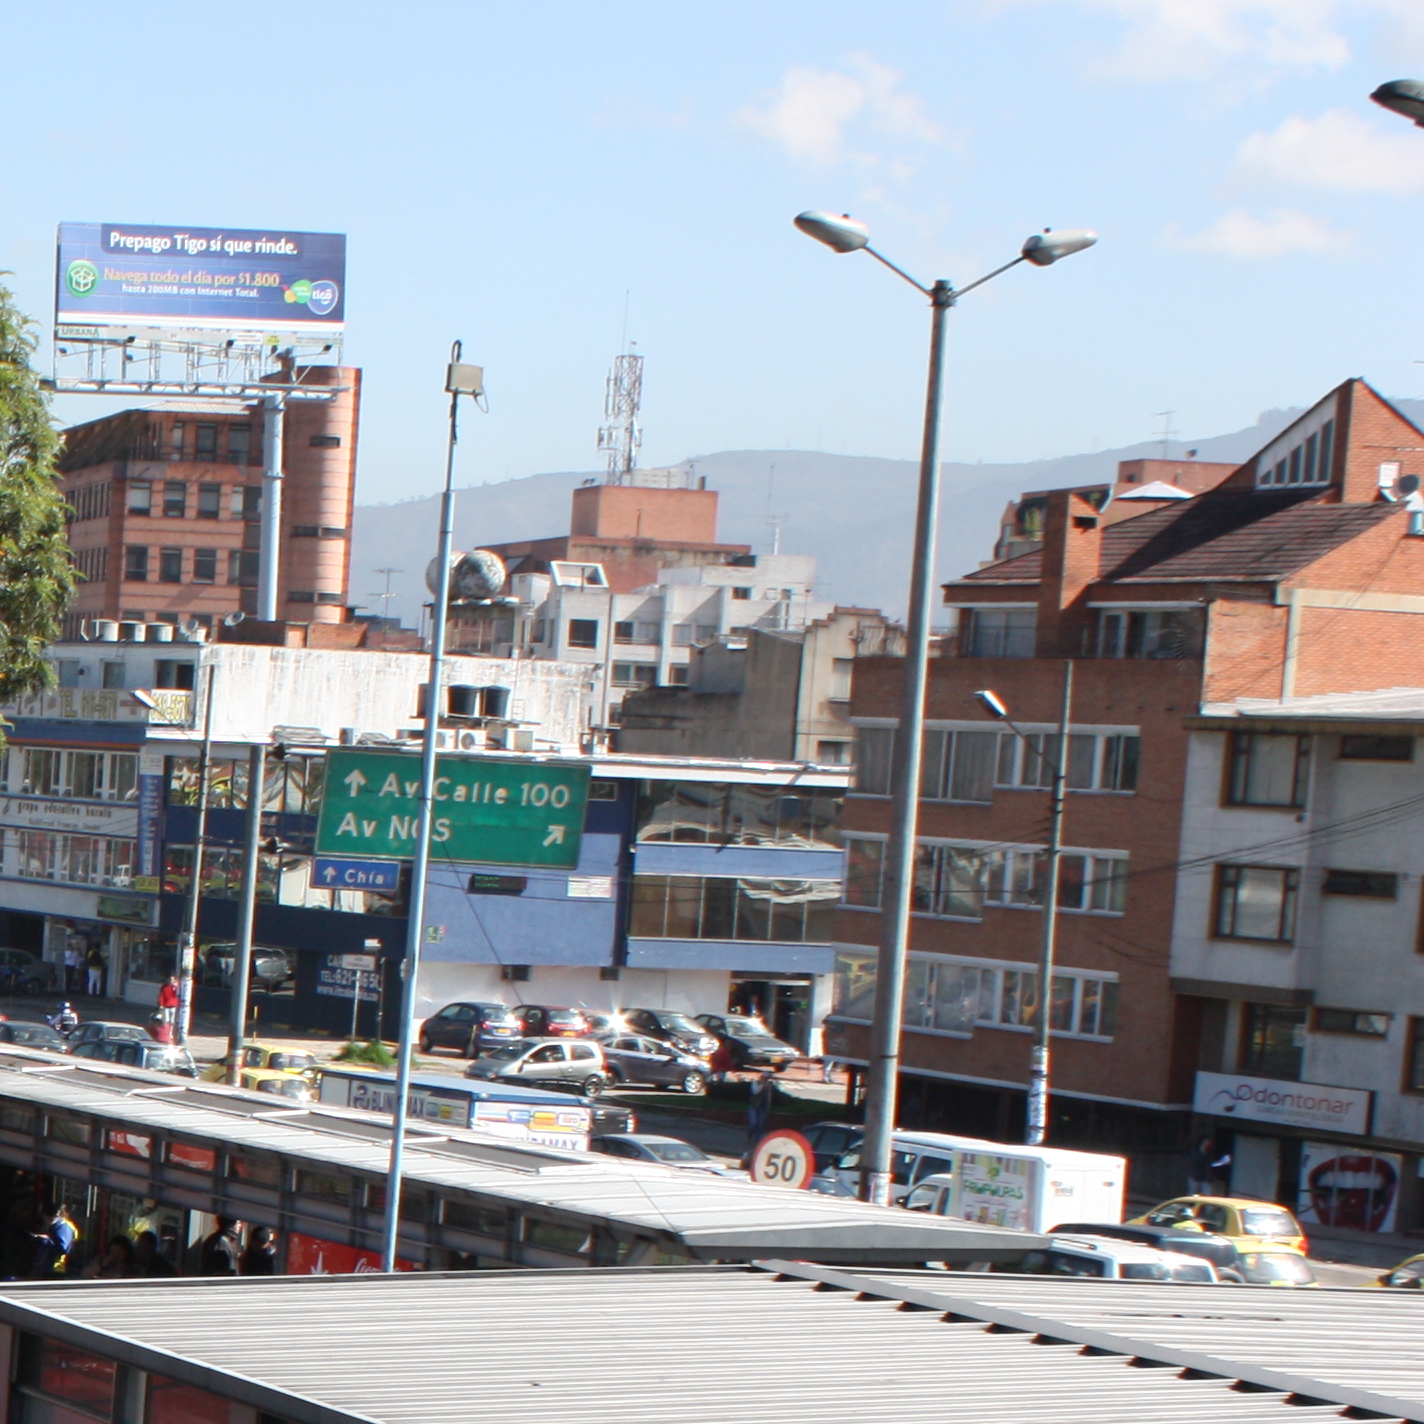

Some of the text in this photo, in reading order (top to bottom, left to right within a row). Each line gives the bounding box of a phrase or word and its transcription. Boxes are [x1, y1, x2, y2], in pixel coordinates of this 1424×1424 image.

[110, 232, 171, 254] Prepago
[224, 240, 252, 256] que
[104, 268, 147, 285] Navega
[150, 269, 179, 284] todo
[181, 270, 192, 284] el
[214, 274, 237, 287] por
[238, 272, 280, 287] $1.800
[122, 284, 146, 294] hasta
[179, 287, 196, 296] con
[197, 286, 233, 297] Internet
[379, 772, 570, 809] Av Calle 100
[336, 811, 377, 838] Av
[344, 868, 384, 885] Chía
[1235, 1084, 1354, 1116] Odontonar
[763, 1154, 797, 1182] 50
